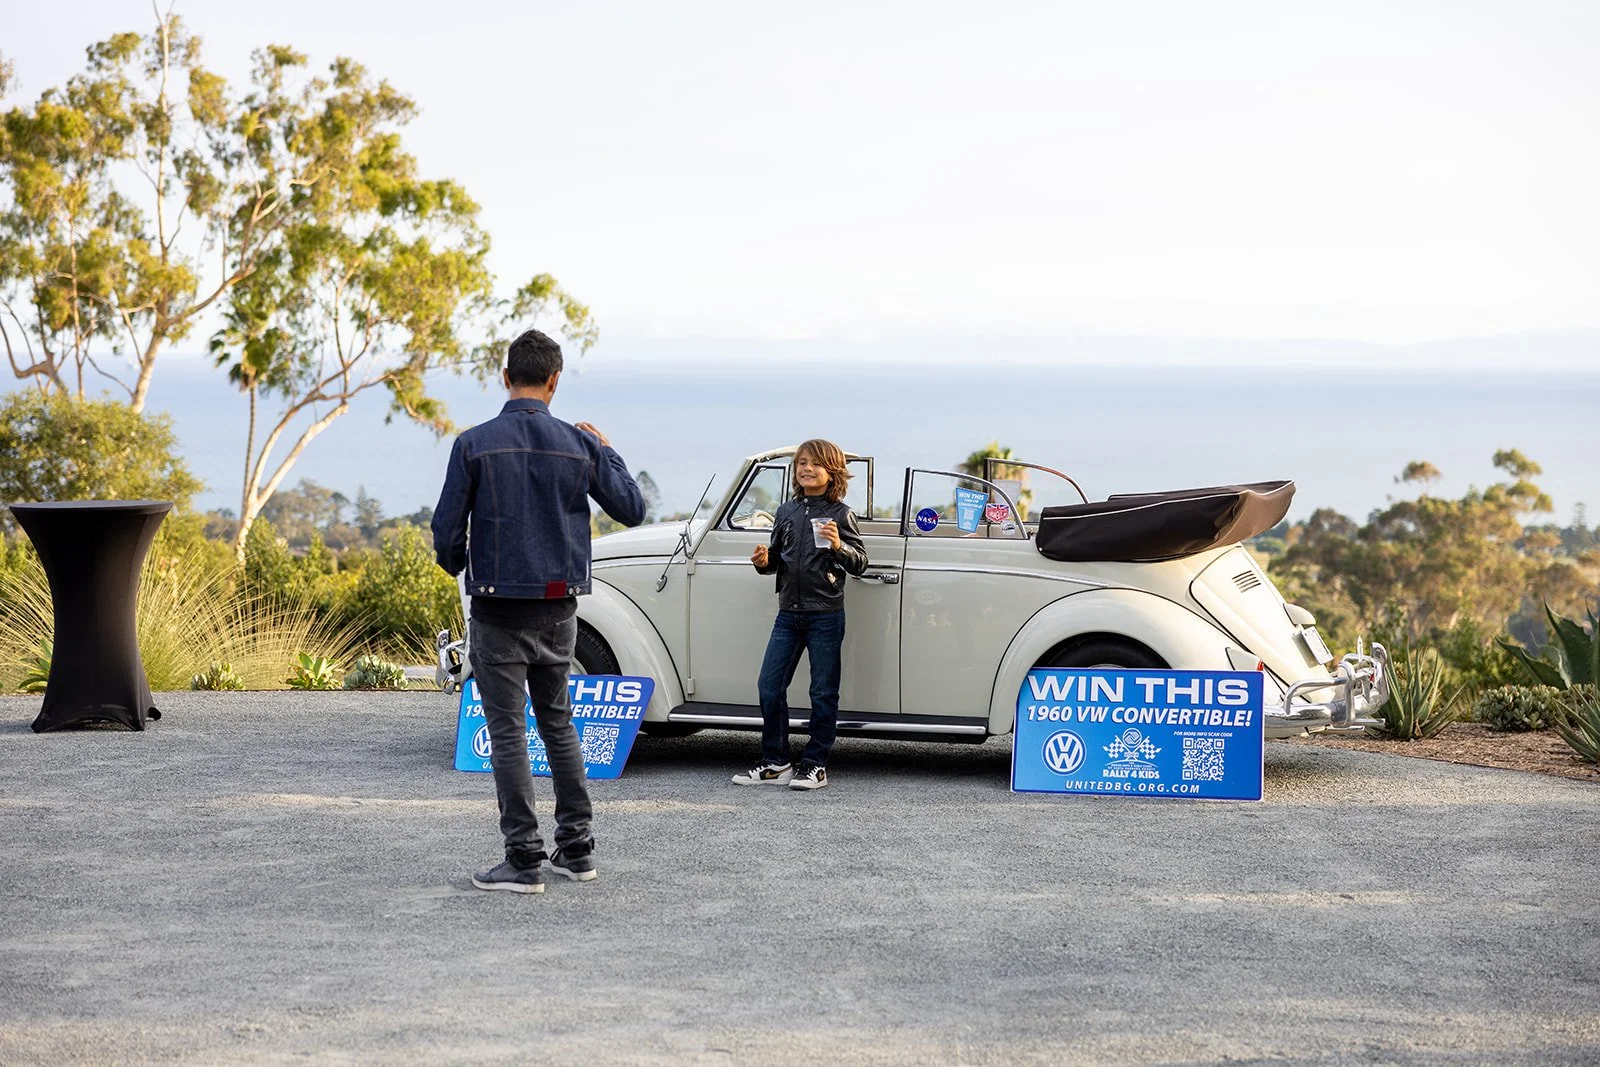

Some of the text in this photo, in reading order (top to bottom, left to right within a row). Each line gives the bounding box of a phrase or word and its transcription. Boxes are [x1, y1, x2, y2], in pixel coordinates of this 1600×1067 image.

[917, 515, 937, 525] NASA
[1028, 675, 1249, 706] WIN THIS
[465, 704, 486, 718] 19
[1027, 705, 1253, 727] 1960 VW CONVERTIBLE!
[1103, 769, 1160, 779] RALLY 4 KIDS
[1065, 780, 1200, 794] UNITEDBG.ORG.COM
